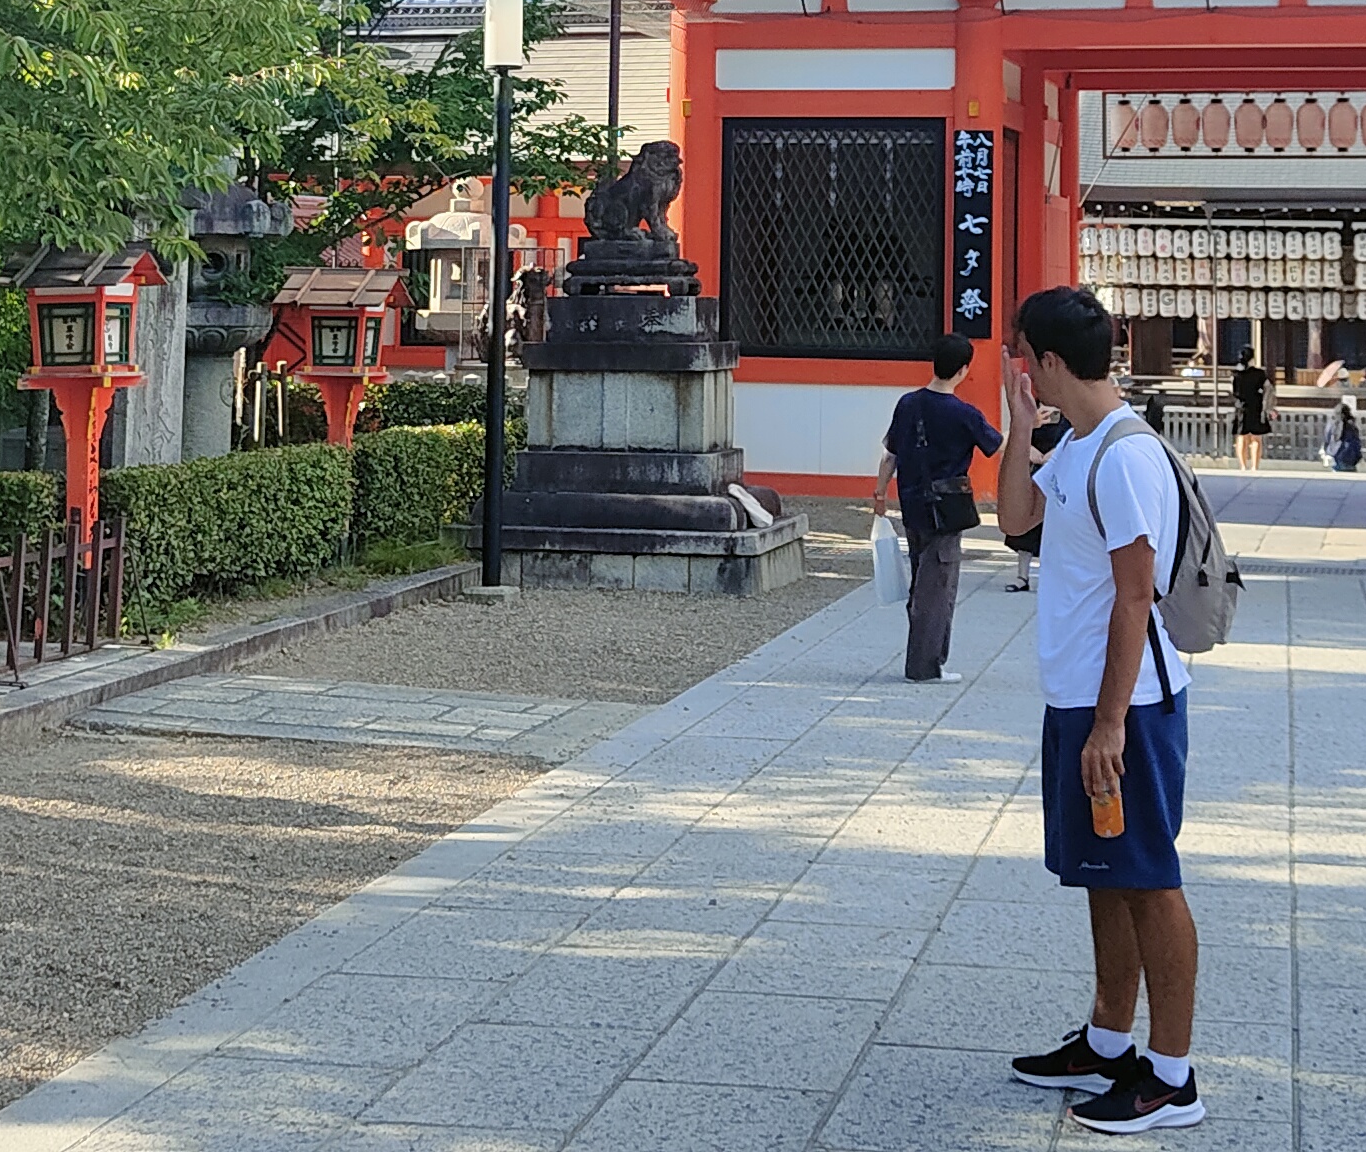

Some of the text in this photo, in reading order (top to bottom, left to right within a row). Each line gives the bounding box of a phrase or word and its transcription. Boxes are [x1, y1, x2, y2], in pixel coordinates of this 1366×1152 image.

[955, 130, 975, 197] 午前十時
[974, 133, 993, 194] 八月七日
[956, 213, 989, 320] 七夕祭
